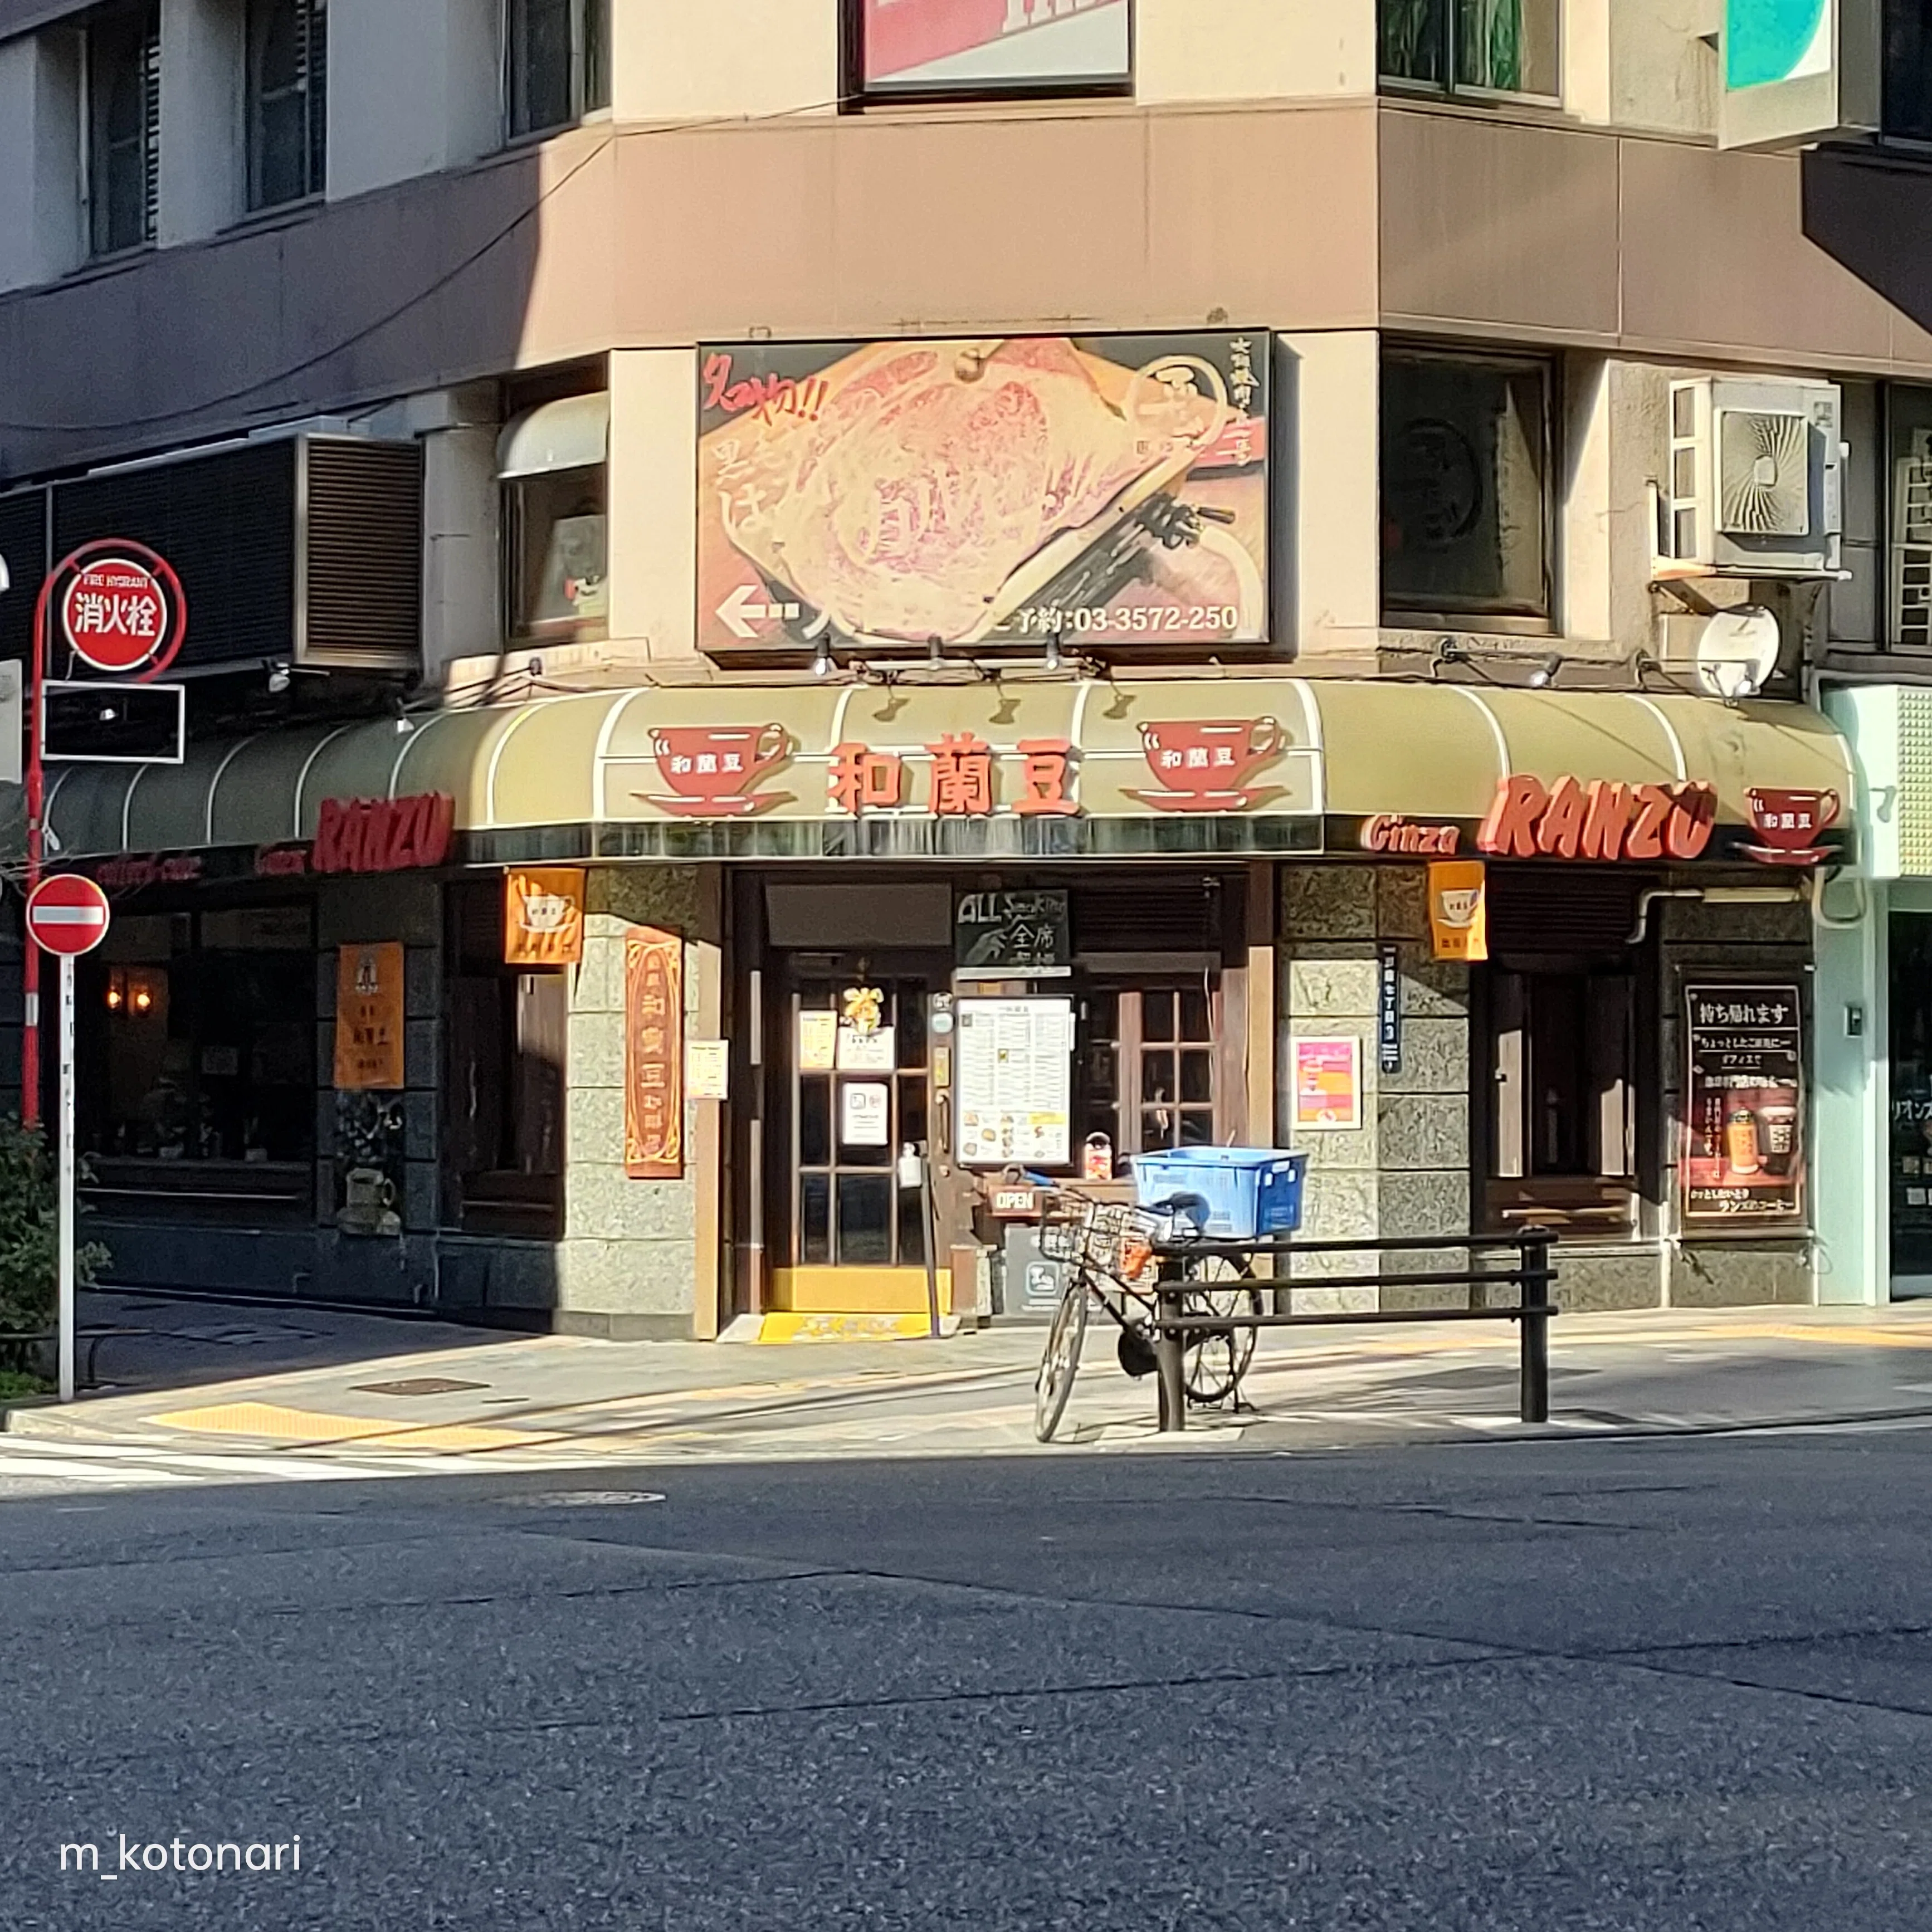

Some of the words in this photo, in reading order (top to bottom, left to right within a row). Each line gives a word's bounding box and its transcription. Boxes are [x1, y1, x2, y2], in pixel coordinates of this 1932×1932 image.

[75, 592, 158, 636] 消火栓
[827, 732, 1081, 817] 和蘭豆
[312, 791, 456, 873] RANZU
[1361, 813, 1461, 856] Ginza
[1476, 774, 1718, 861] RANZU
[958, 892, 1002, 923] ALL
[1010, 923, 1055, 949] 全席
[1700, 1003, 1789, 1024] 持ち帰れます
[997, 1192, 1034, 1209] OPEN
